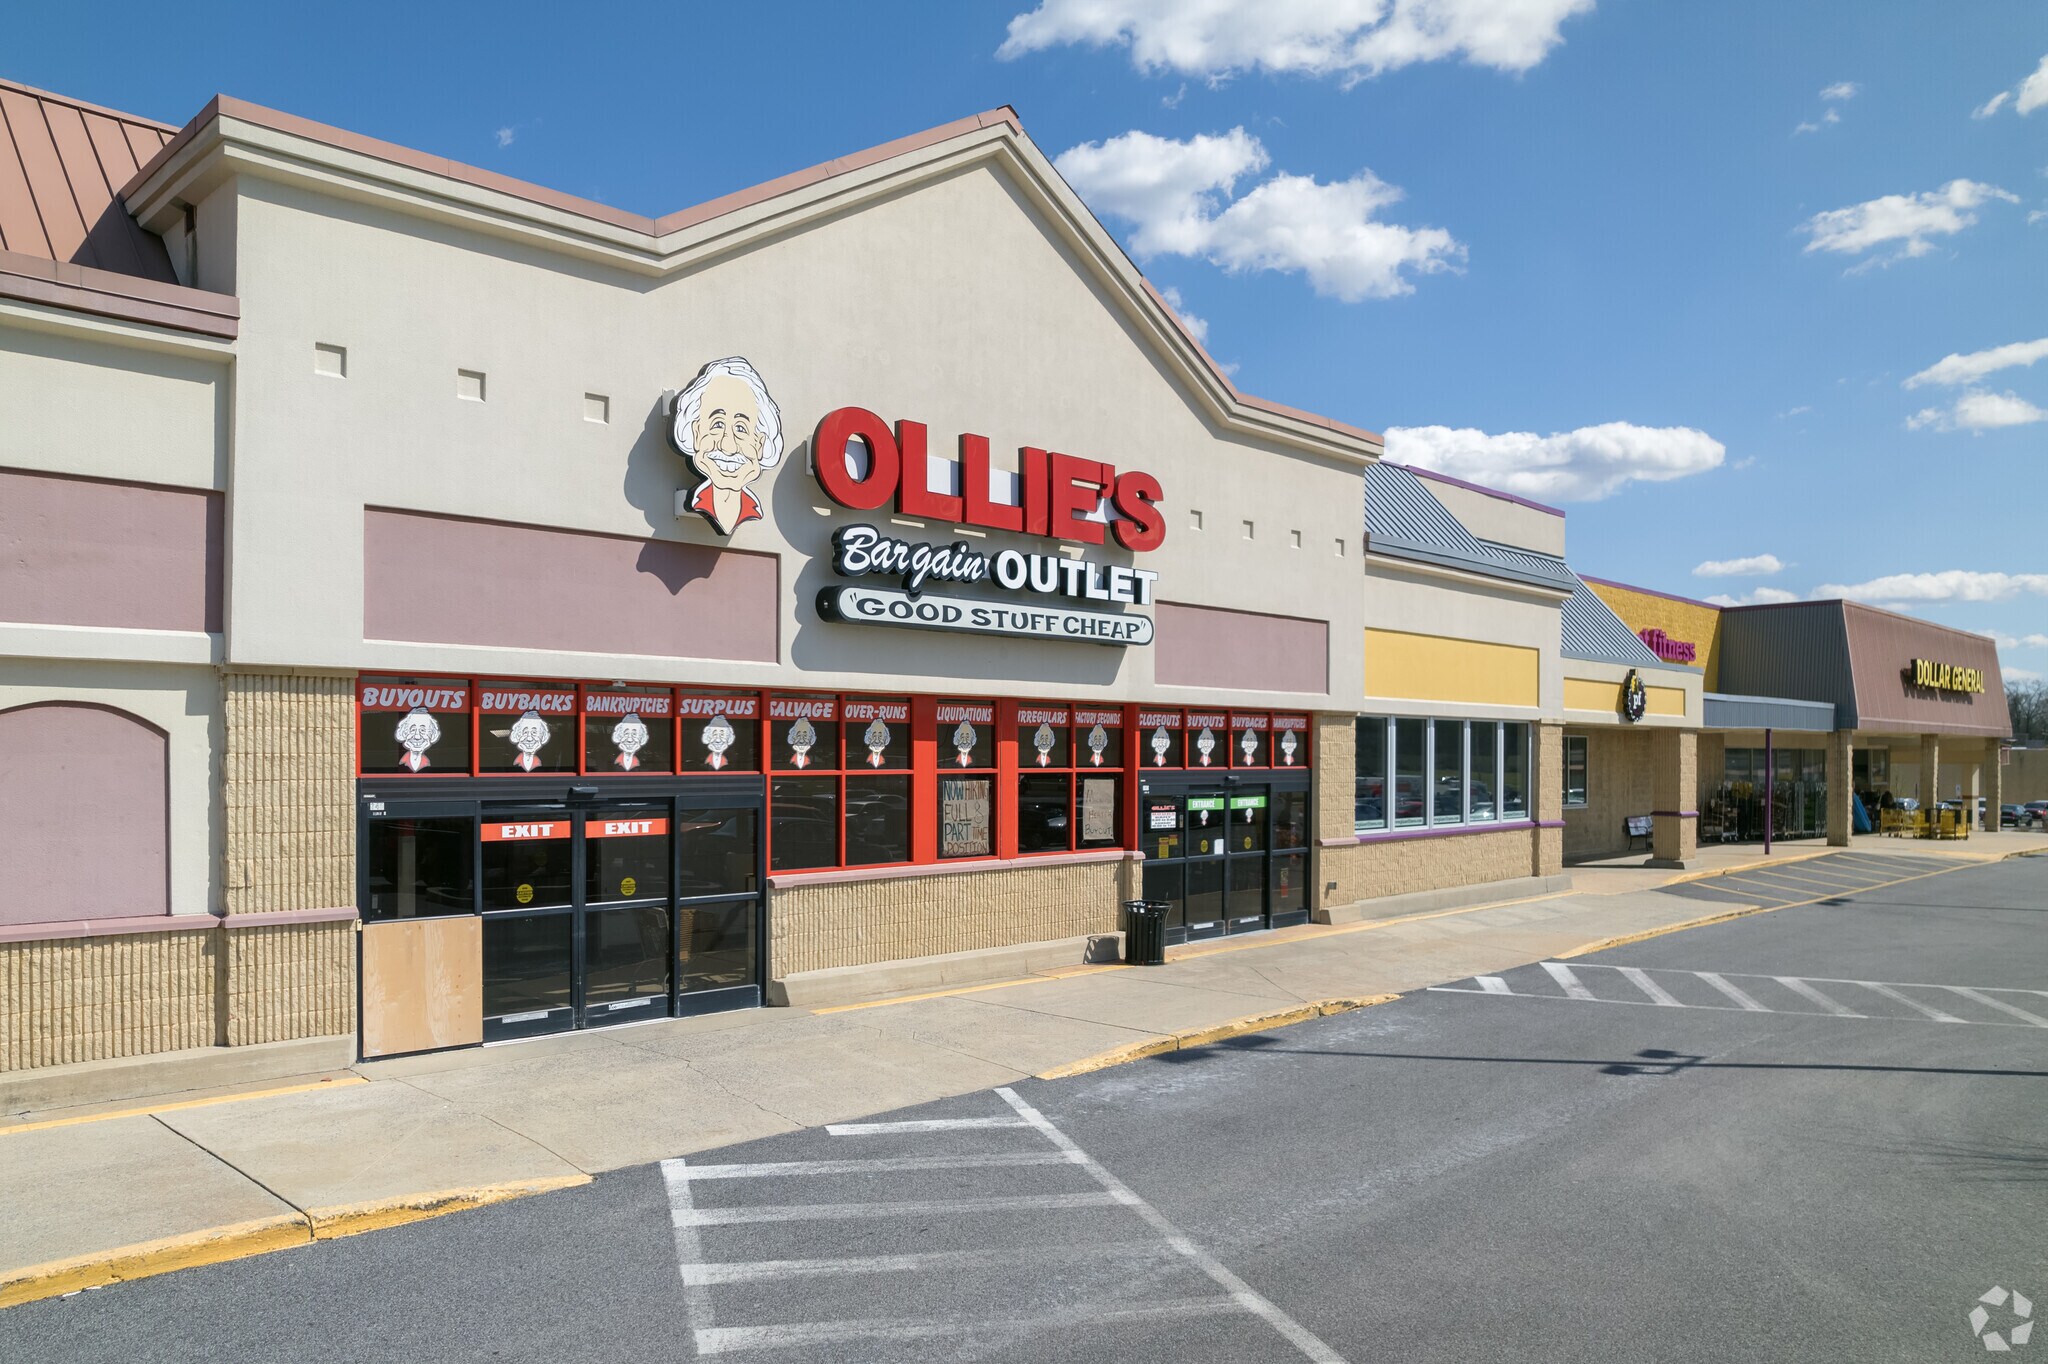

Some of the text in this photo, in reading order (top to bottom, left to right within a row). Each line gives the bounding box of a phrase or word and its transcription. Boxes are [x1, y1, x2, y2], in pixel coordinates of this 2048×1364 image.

[812, 406, 1166, 552] OLLIE'S
[841, 526, 1159, 606] Bargain OUTLET
[971, 608, 1059, 632] STUFF
[1652, 628, 1697, 662] fitness
[1916, 658, 1986, 694] DOLLAR GENERAL
[362, 687, 466, 709] BUYOUTS
[481, 692, 575, 712] BUYBACKS
[586, 695, 670, 714] BANKRUPTCIES
[680, 698, 756, 716] SURPLUS
[1632, 690, 1643, 709] pf
[769, 701, 834, 718] SALVAGE
[845, 704, 907, 720] OVER-RUNS
[936, 706, 993, 722] LIQUIDATIONS
[1018, 709, 1068, 725] IRREGULARS
[1075, 711, 1121, 725] FACTORY SECONDS
[1139, 713, 1181, 727] CLOSEOUTS
[1187, 714, 1226, 728] BUYOUTS
[1231, 716, 1269, 729] BUYBACKS
[943, 780, 989, 801] NOW HIRING
[944, 803, 972, 822] FULL
[501, 823, 554, 839] EXIT
[604, 820, 653, 836] EXIT
[944, 823, 989, 842] PART TIME
